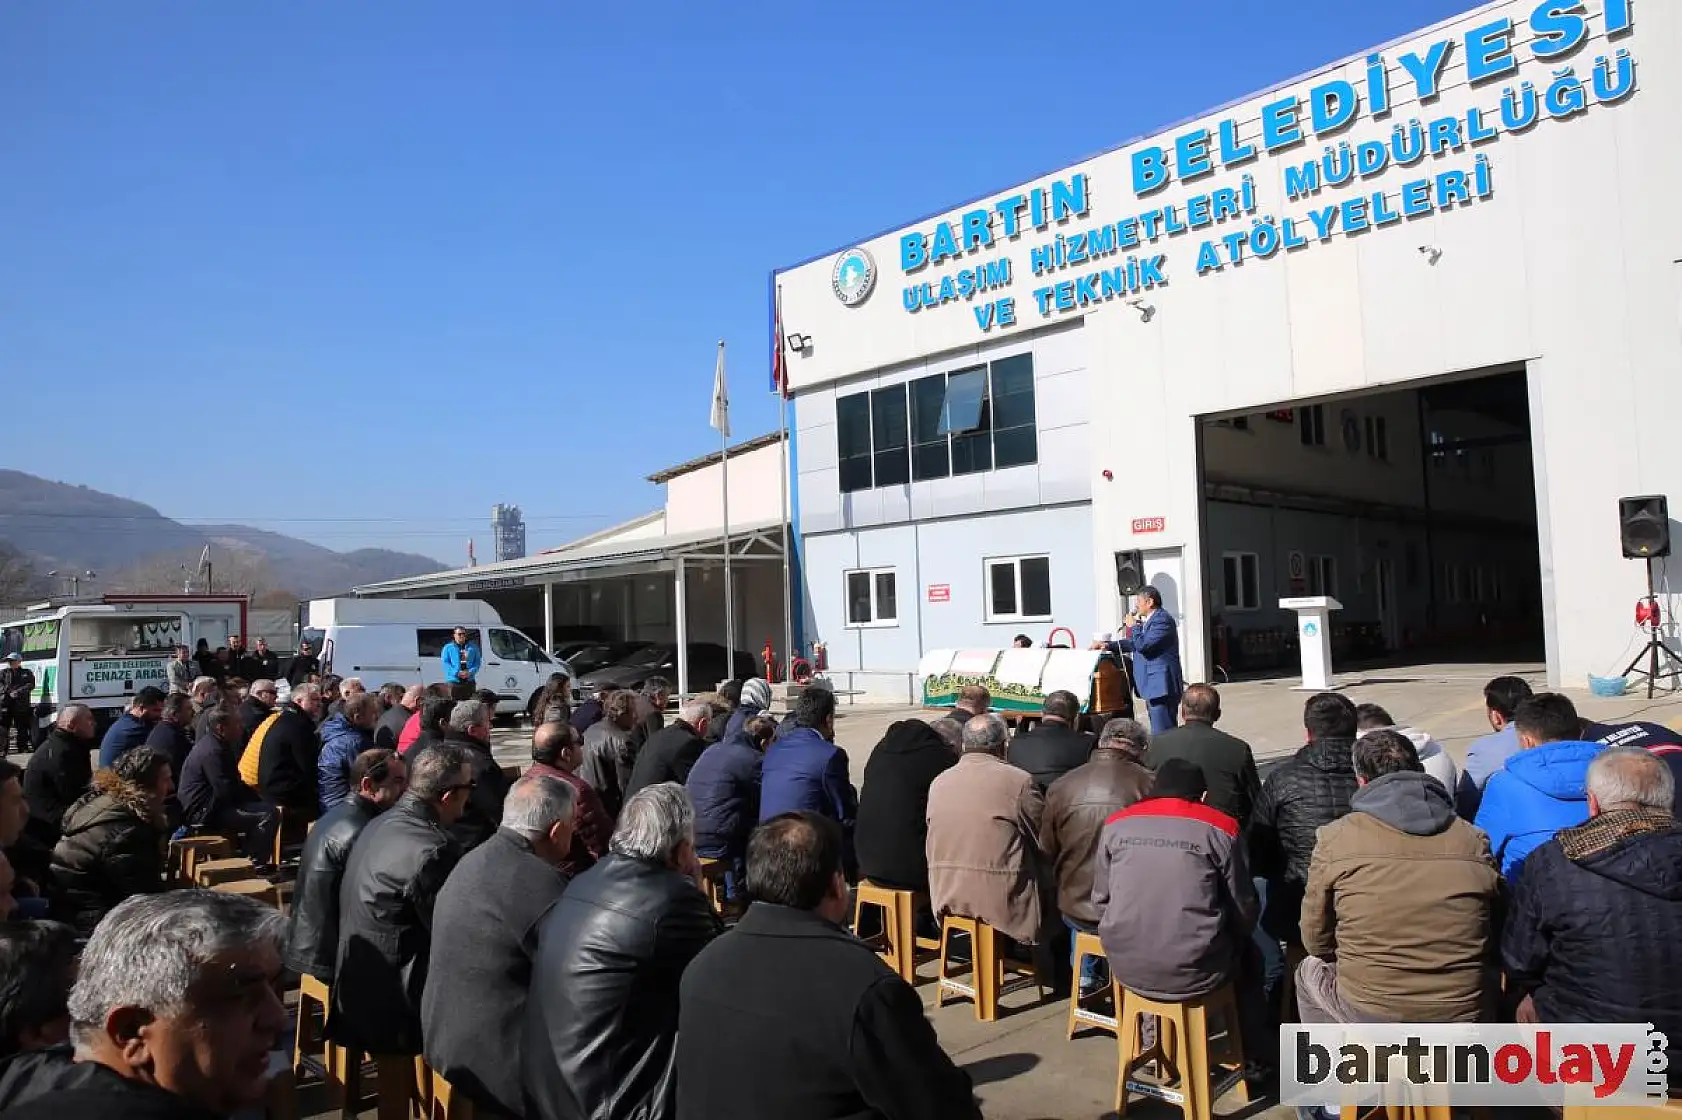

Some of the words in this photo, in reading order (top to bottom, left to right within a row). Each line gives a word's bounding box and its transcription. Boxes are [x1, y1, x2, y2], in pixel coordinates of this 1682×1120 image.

[900, 173, 1086, 271] BARTIN
[902, 257, 1010, 312] ULAŞIM
[1030, 176, 1254, 273] HİZMETLERİ
[1285, 48, 1634, 196] MÜDÜRLÜĞÜ
[973, 297, 1015, 330] VE
[1032, 256, 1166, 315] TEKNİK
[1197, 153, 1490, 271] ATÖLYELERİ
[86, 671, 132, 682] CENAZE
